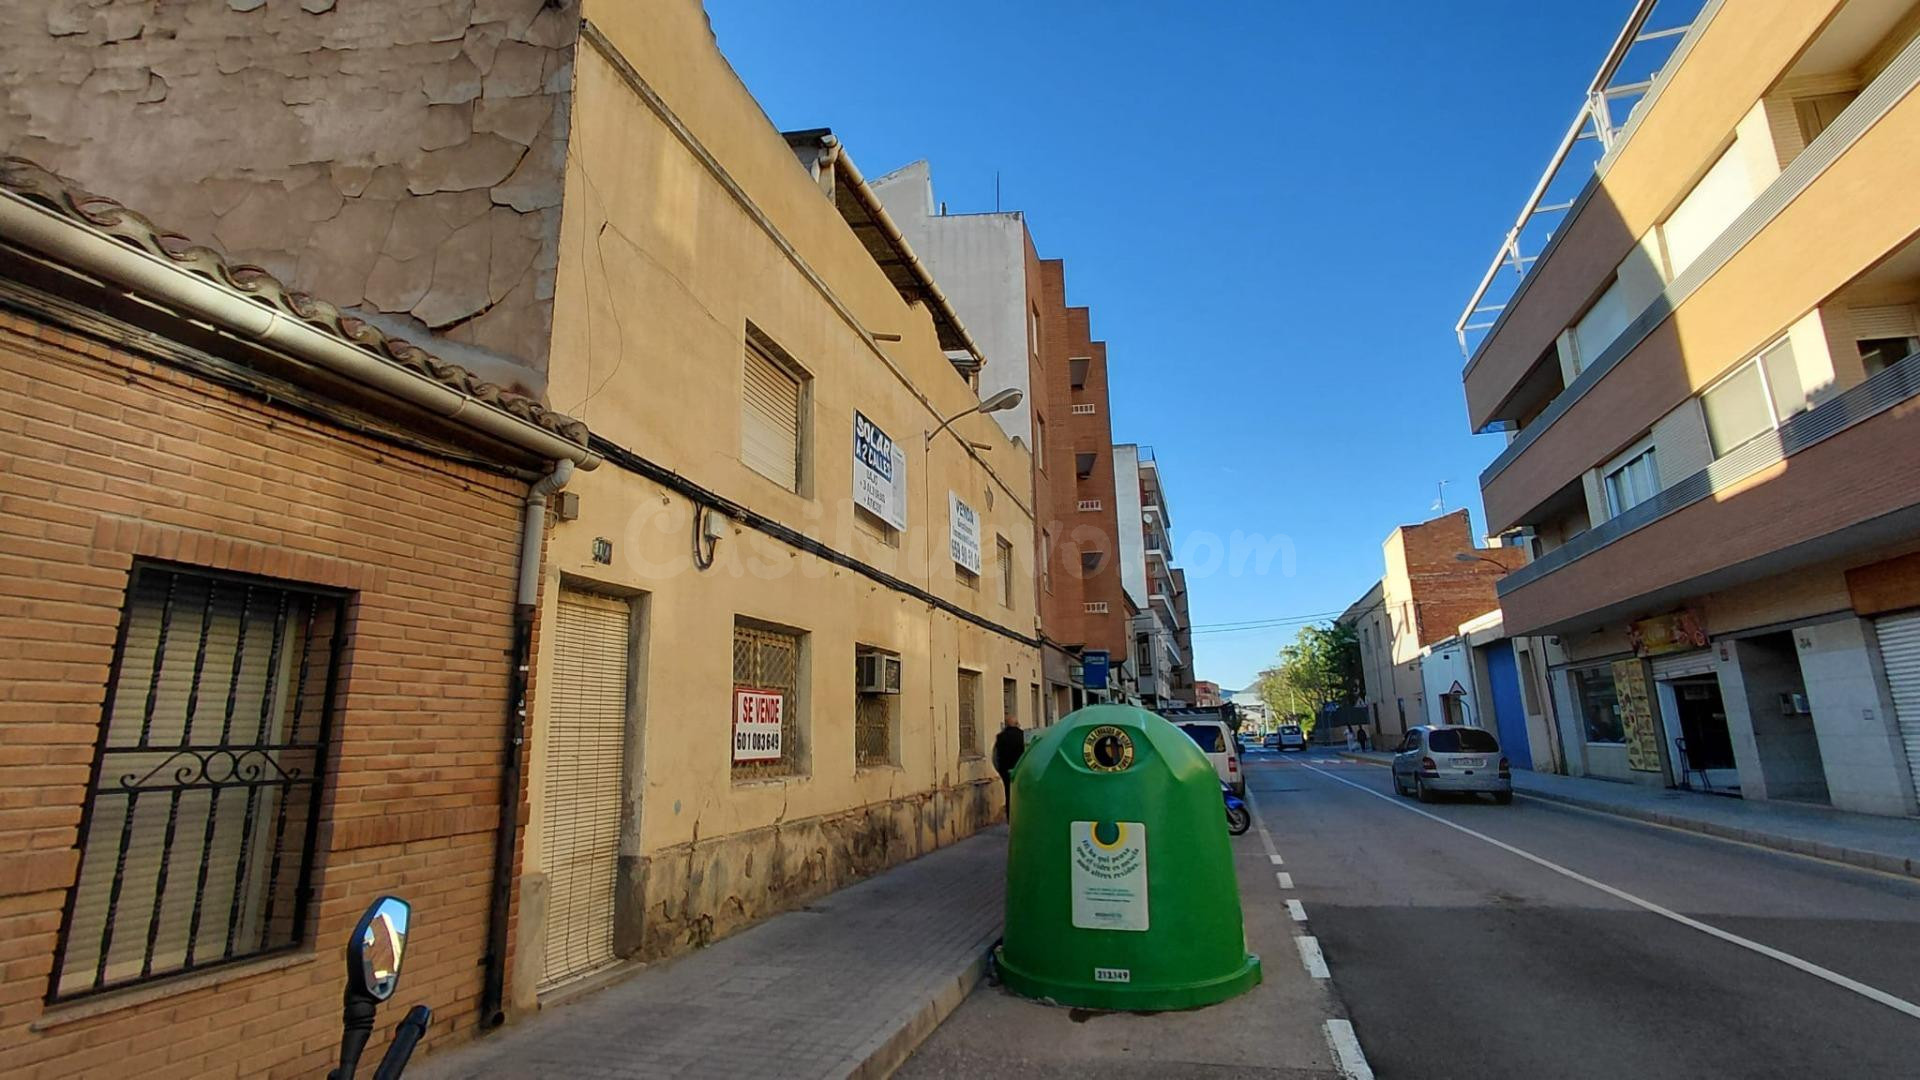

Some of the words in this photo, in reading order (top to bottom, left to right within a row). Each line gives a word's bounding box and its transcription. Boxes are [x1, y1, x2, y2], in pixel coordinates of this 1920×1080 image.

[857, 415, 891, 462] SOLAR
[862, 443, 868, 461] 2
[743, 697, 753, 723] SE
[755, 698, 779, 723] VENDE
